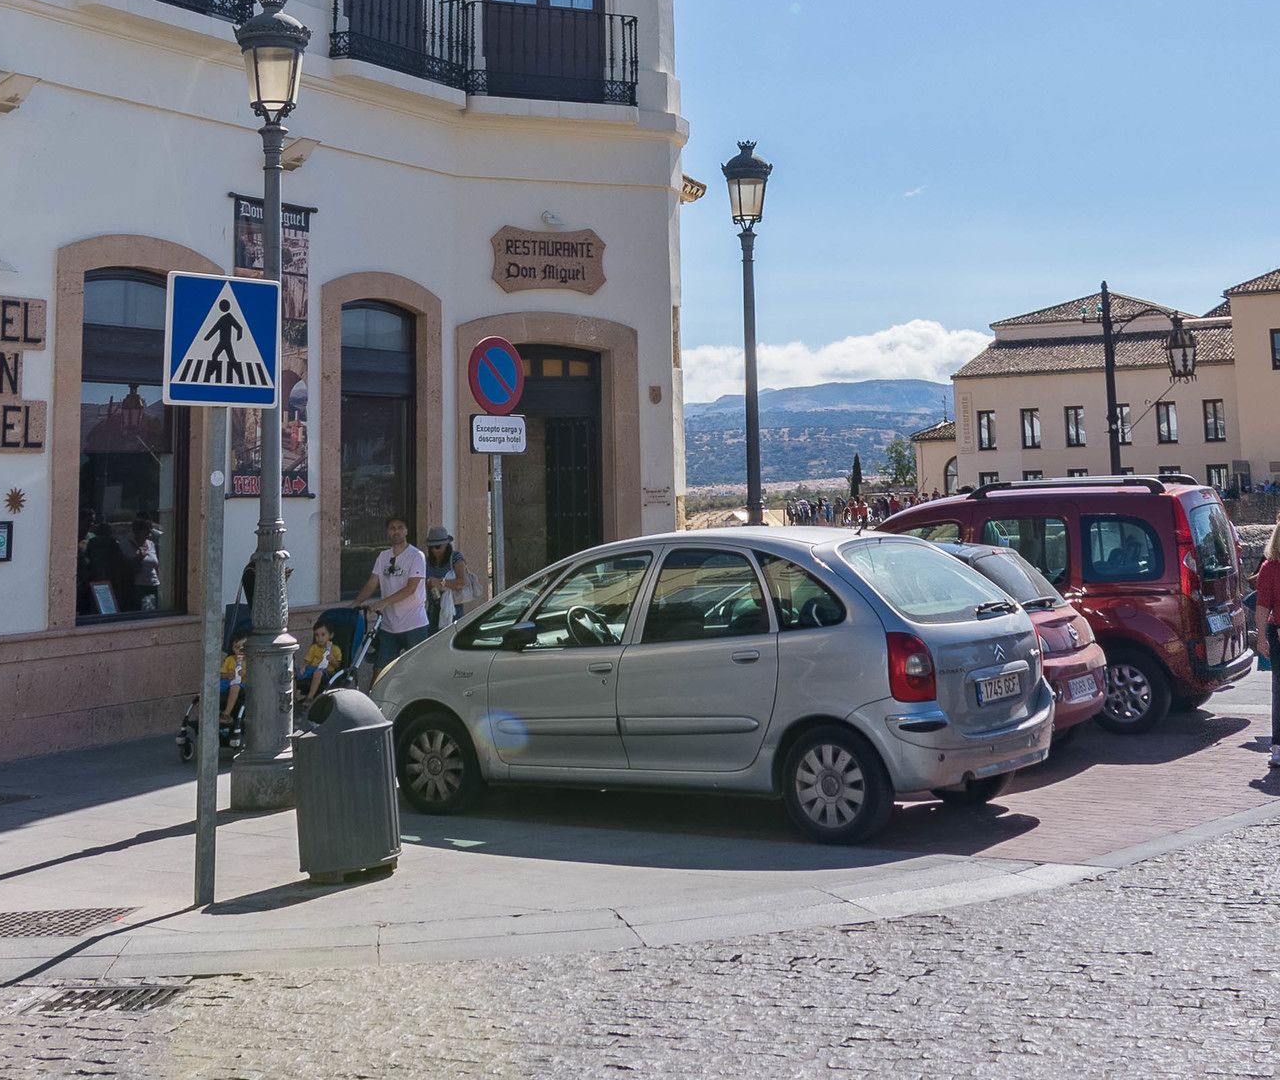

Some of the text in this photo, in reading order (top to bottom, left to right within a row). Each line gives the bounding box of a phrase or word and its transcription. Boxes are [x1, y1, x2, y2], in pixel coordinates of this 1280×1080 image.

[240, 201, 263, 219] Don
[505, 239, 594, 258] RESTAURANTE
[505, 262, 586, 283] Don Miguel
[476, 424, 500, 434] Excepto
[501, 426, 518, 434] carga
[478, 435, 505, 444] descarga
[234, 475, 293, 494] TERA
[984, 680, 1003, 699] 1745
